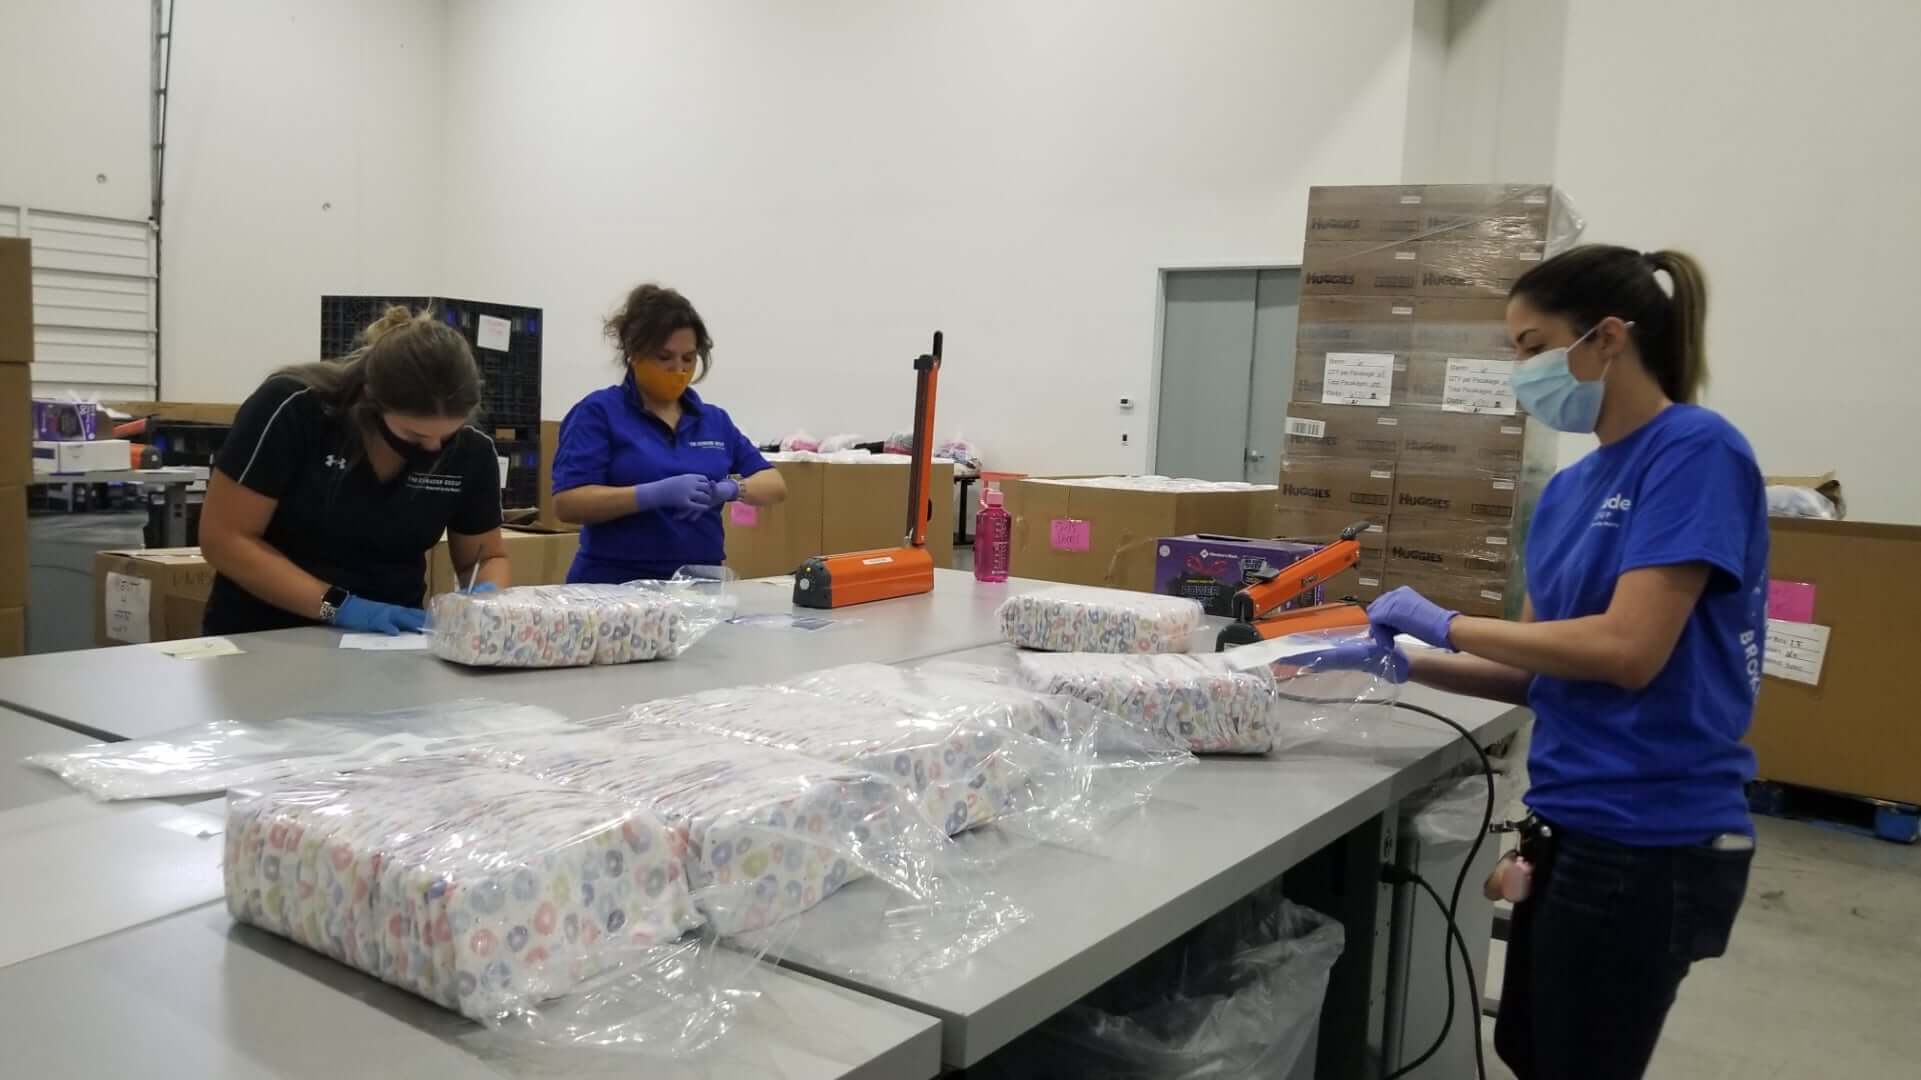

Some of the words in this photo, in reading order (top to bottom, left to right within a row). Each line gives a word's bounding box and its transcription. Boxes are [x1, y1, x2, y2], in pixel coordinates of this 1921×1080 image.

[1306, 273, 1355, 285] HUGGIES
[1282, 483, 1331, 499] HUGGIES
[1399, 493, 1451, 509] HUGGIES
[1392, 546, 1443, 563] HUGGIES
